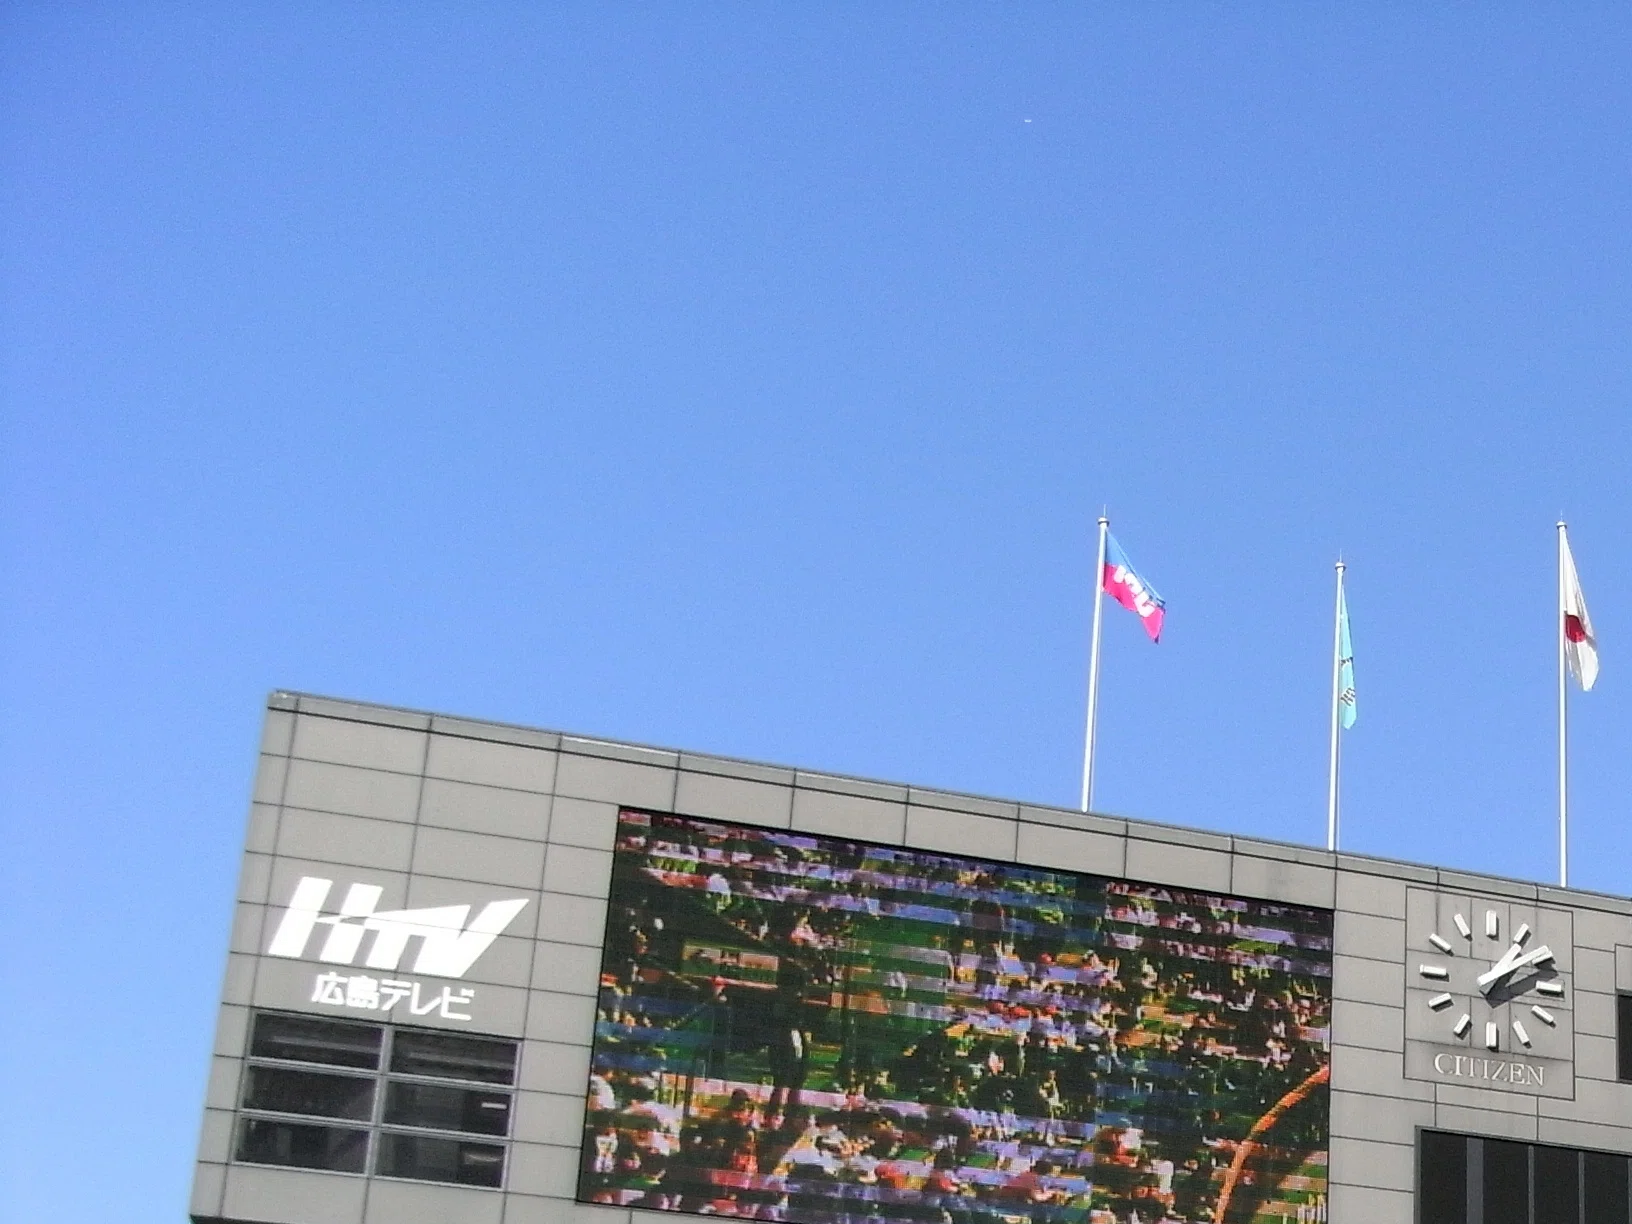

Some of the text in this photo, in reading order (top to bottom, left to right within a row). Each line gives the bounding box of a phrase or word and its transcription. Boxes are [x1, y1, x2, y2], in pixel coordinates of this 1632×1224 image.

[311, 971, 474, 1021] 広島テレビ
[1434, 1053, 1545, 1086] CITIZEN
